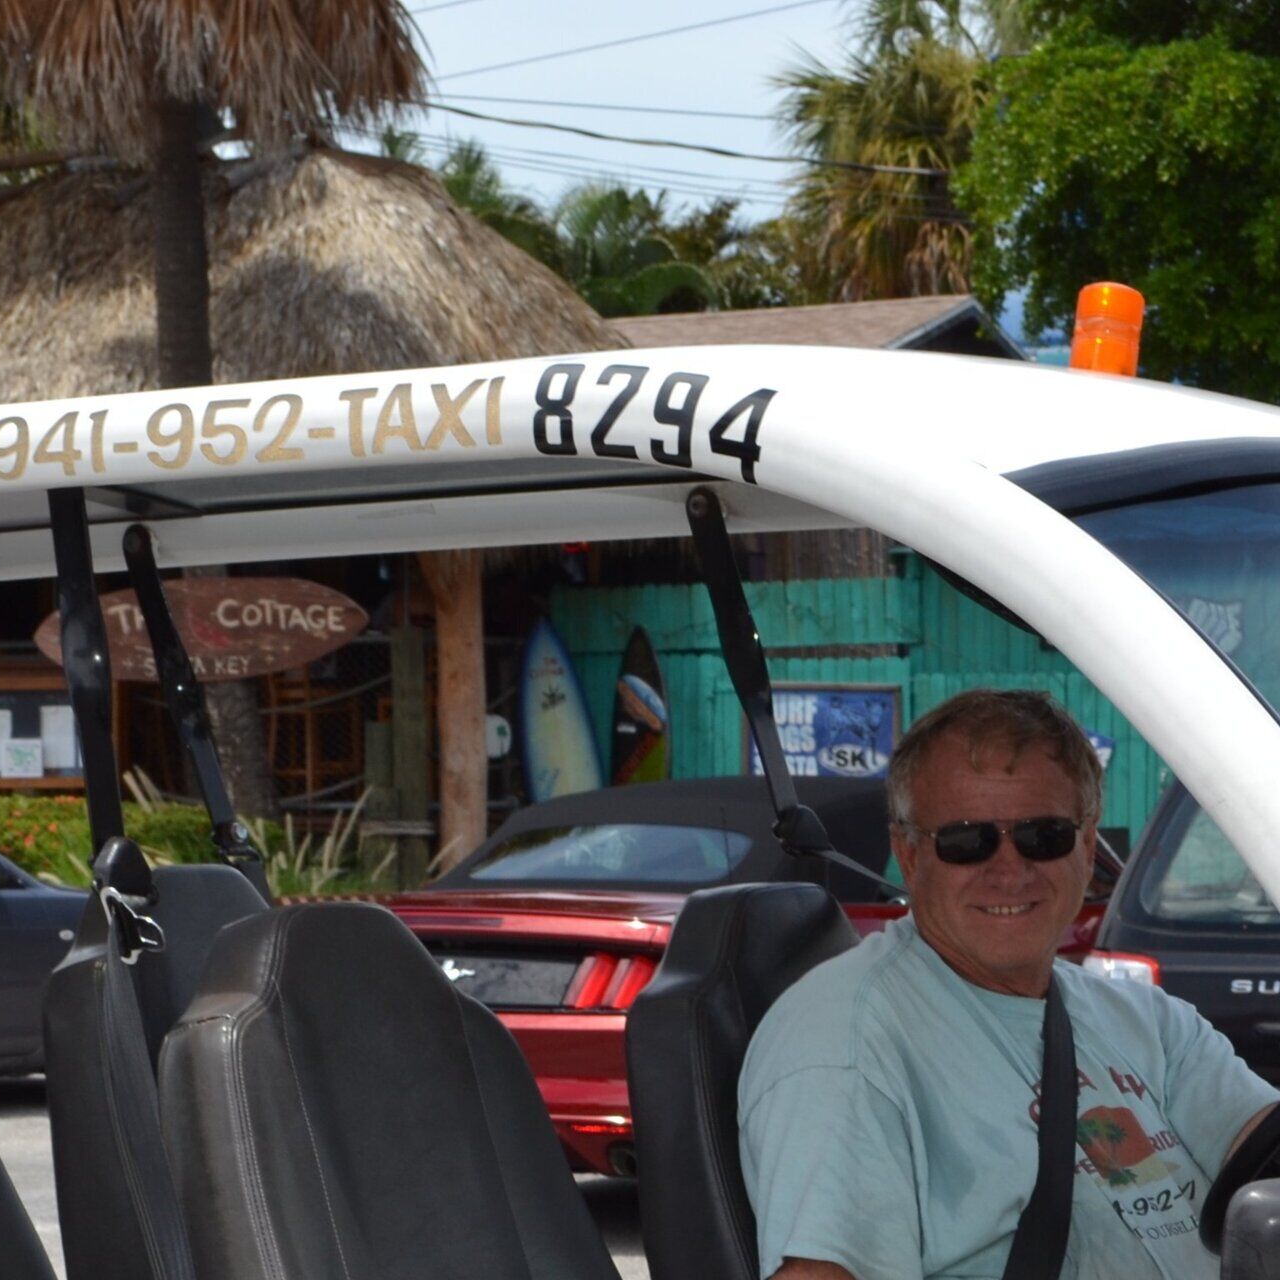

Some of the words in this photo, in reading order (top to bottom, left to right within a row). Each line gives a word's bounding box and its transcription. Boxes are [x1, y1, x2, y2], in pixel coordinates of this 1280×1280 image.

[532, 362, 780, 486] 8294
[216, 598, 348, 632] COTTAGE
[771, 692, 818, 724] URF
